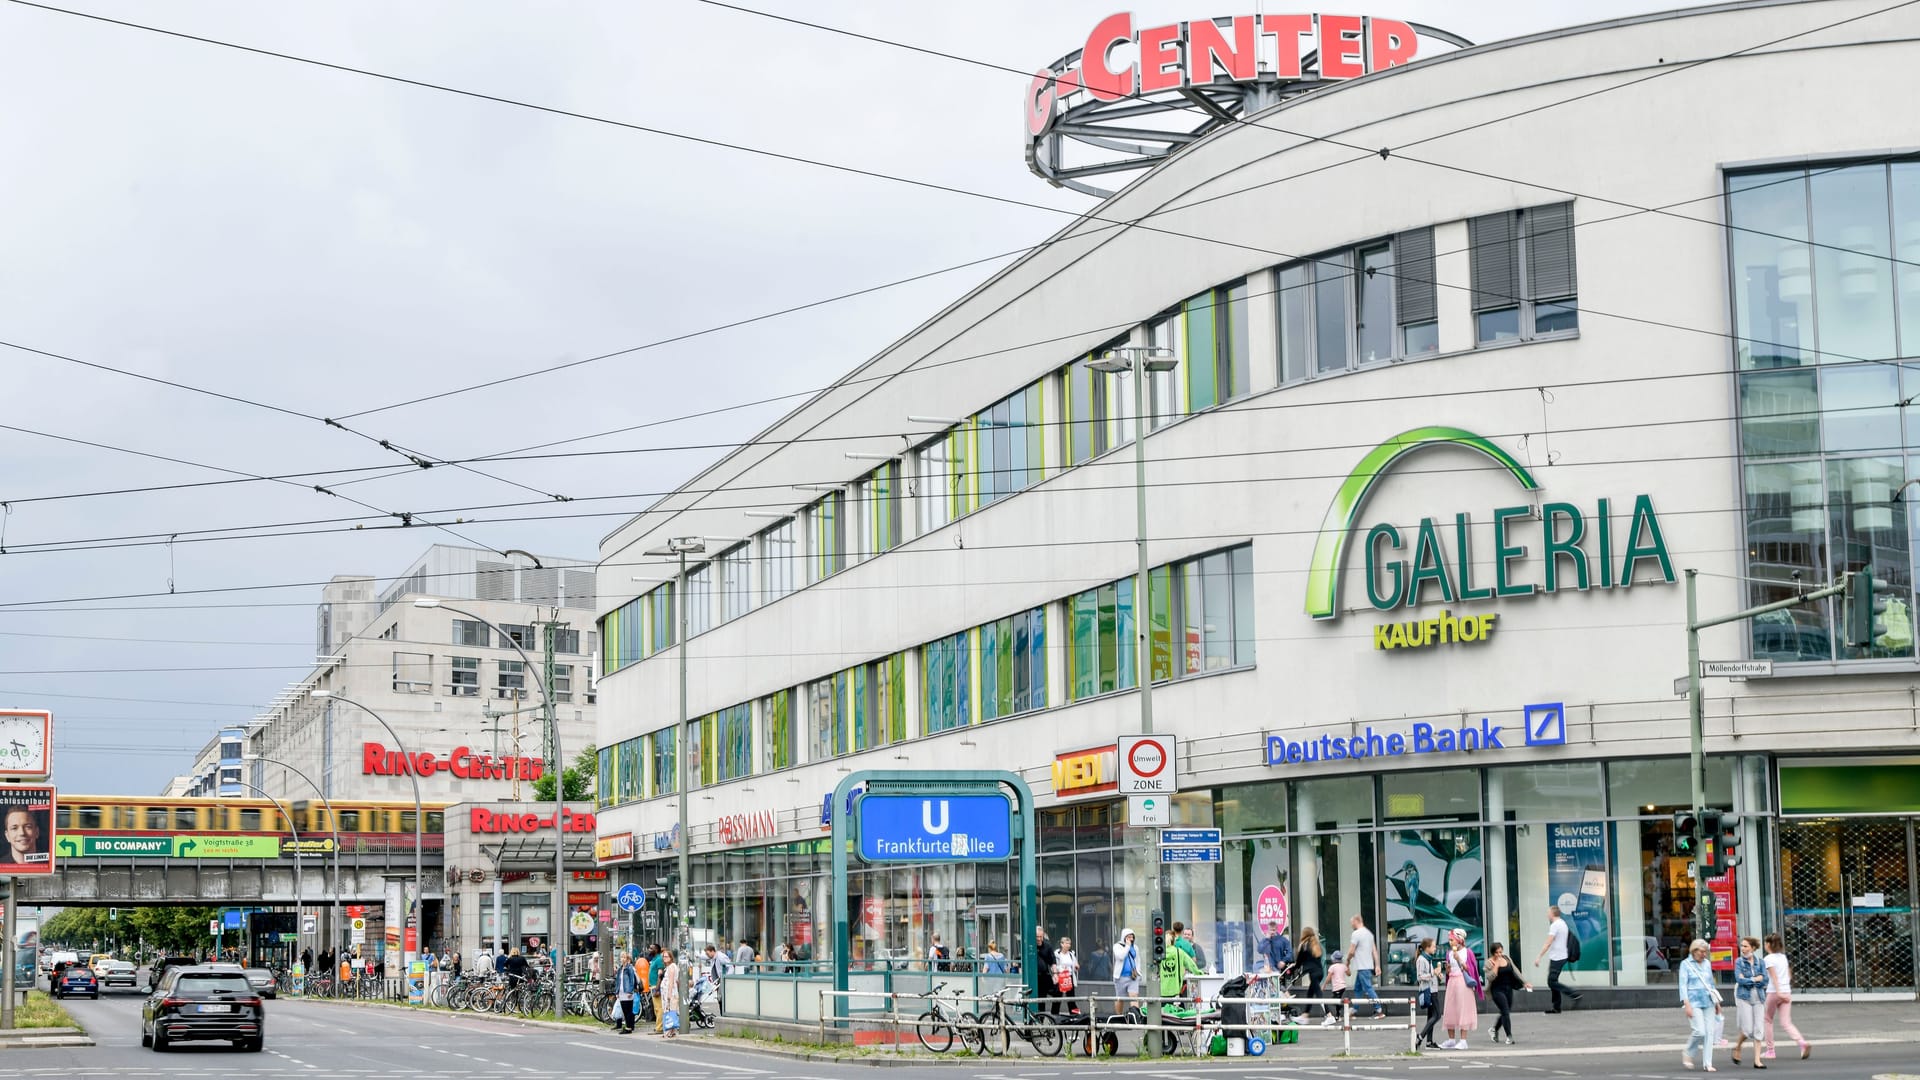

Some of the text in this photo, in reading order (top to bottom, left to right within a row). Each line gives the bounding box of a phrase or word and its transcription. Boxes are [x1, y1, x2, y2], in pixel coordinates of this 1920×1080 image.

[1365, 493, 1678, 612] GALERIA
[1267, 717, 1506, 766] Deutsche Bank
[1133, 755, 1162, 763] Umwelt
[1133, 780, 1163, 790] ZONE
[922, 799, 950, 835] U
[1142, 815, 1157, 823] frei
[718, 808, 776, 845] ROSSMANN
[95, 841, 112, 850] BIO
[877, 838, 955, 854] Frankfurte
[1555, 839, 1600, 849] ERLEBEN!
[1260, 903, 1284, 917] 50%
